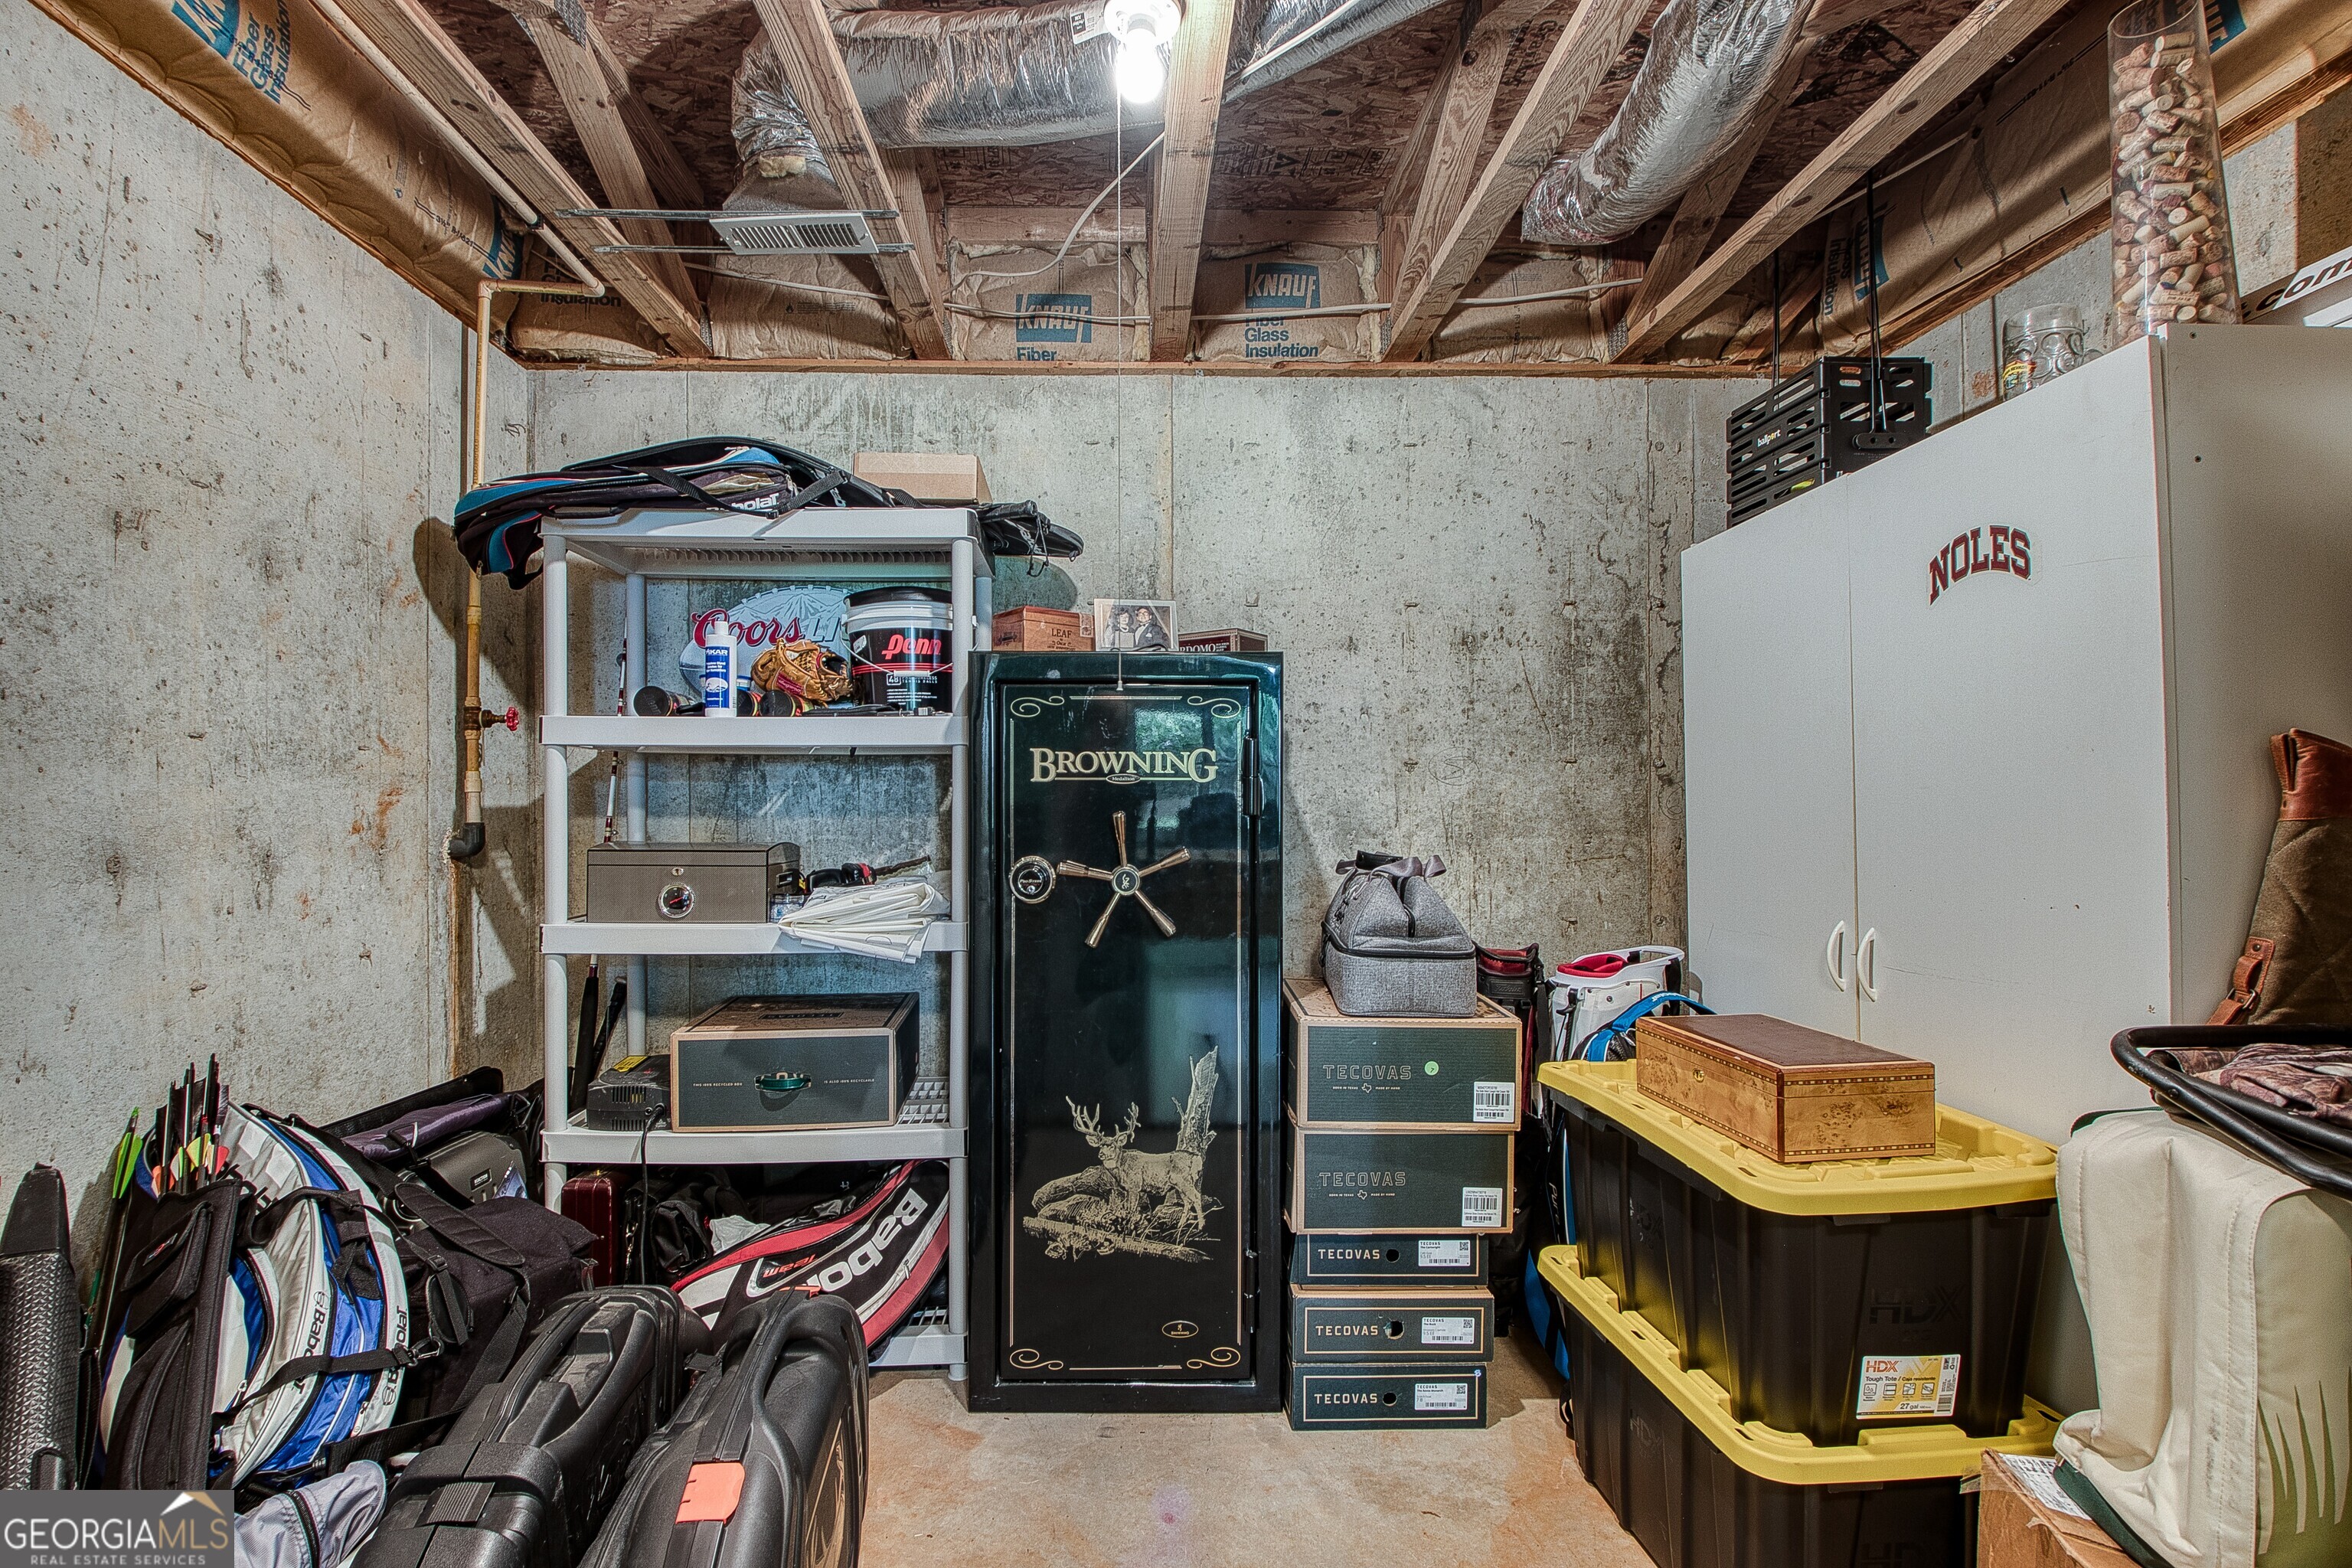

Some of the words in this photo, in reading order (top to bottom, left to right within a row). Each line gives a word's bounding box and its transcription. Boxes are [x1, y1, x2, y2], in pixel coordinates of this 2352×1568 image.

[232, 11, 260, 77] Fiber
[249, 24, 276, 90] Glass
[1824, 238, 1843, 316] Insulation
[1247, 263, 1318, 309] KNAUF
[1245, 327, 1289, 342] Glass
[1017, 347, 1057, 361] Fiber
[1245, 343, 1318, 358] Insulation
[1929, 524, 2031, 606] NOLES
[691, 609, 803, 649] Coors
[1051, 628, 1073, 637] LEAF
[1030, 747, 1218, 782] BROWNING
[1323, 1064, 1412, 1080] TECOVAS
[1319, 1171, 1406, 1187] TECOVAS
[806, 1187, 929, 1293] Babo
[1318, 1249, 1380, 1259] TECOVAS
[1315, 1325, 1378, 1336] TECOVAS
[1865, 1360, 1899, 1373] HDX
[1314, 1393, 1377, 1404] TECOVAS
